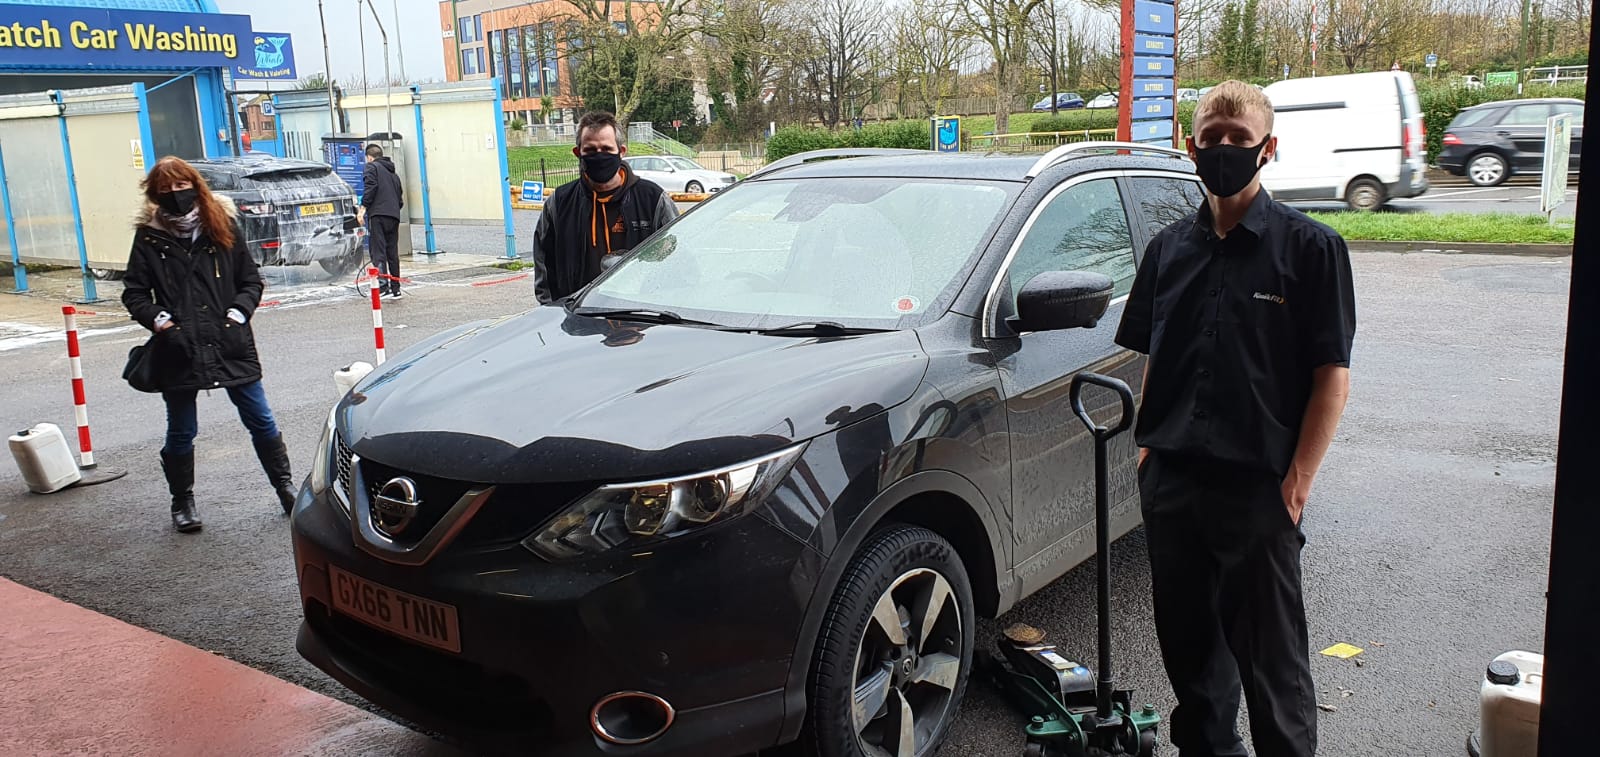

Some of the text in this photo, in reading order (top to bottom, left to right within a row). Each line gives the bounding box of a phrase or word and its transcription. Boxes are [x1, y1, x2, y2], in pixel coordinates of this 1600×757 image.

[69, 20, 118, 49] Car
[124, 23, 237, 58] Washing
[237, 65, 248, 75] Car
[249, 68, 264, 78] Wash
[337, 572, 448, 642] GX66 TNN
